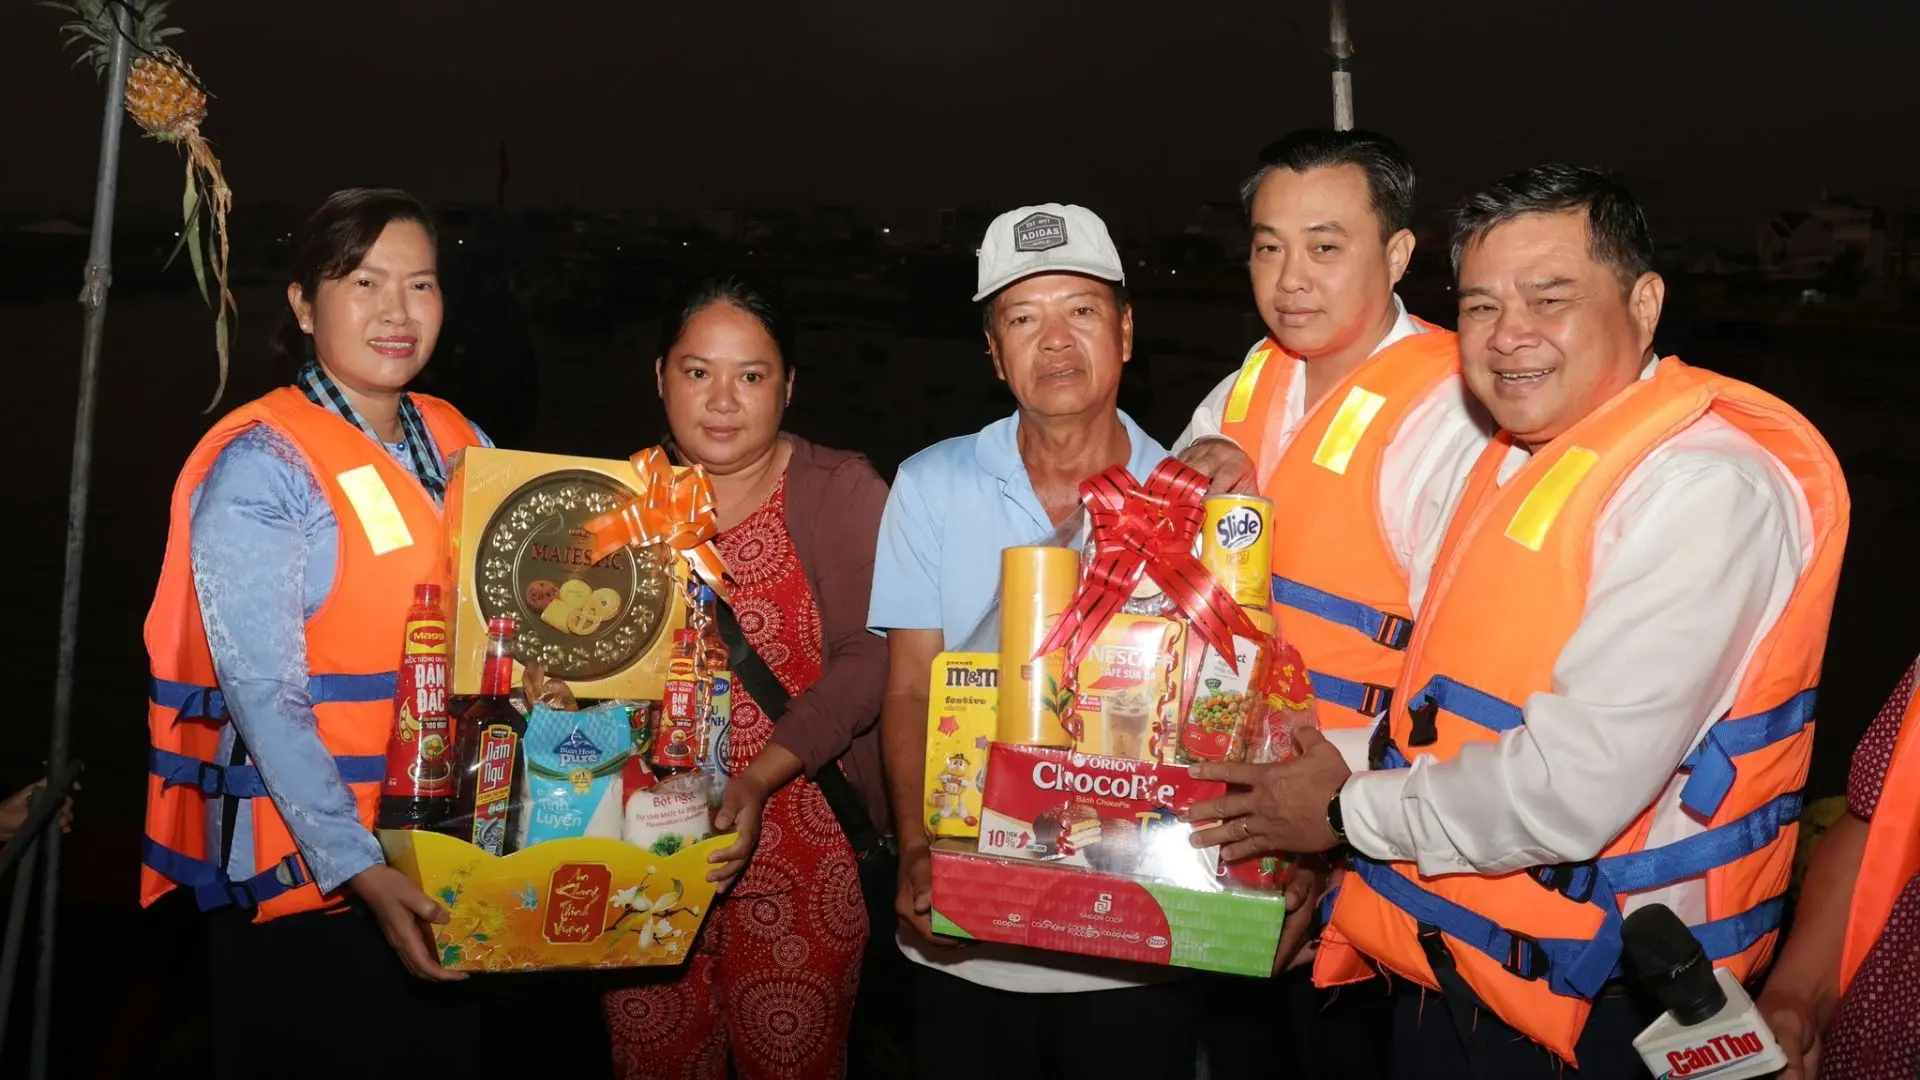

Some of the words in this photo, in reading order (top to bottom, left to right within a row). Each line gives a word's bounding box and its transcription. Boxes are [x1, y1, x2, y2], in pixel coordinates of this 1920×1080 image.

[1022, 227, 1060, 241] ADIDAS
[1217, 513, 1259, 547] Slide
[532, 542, 624, 570] MAJESIC
[945, 696, 986, 705] festive
[486, 741, 510, 761] Nam
[559, 753, 598, 767] pure
[1089, 756, 1137, 773] ORION
[1096, 799, 1130, 809] ChocoPie
[988, 828, 1006, 848] 10
